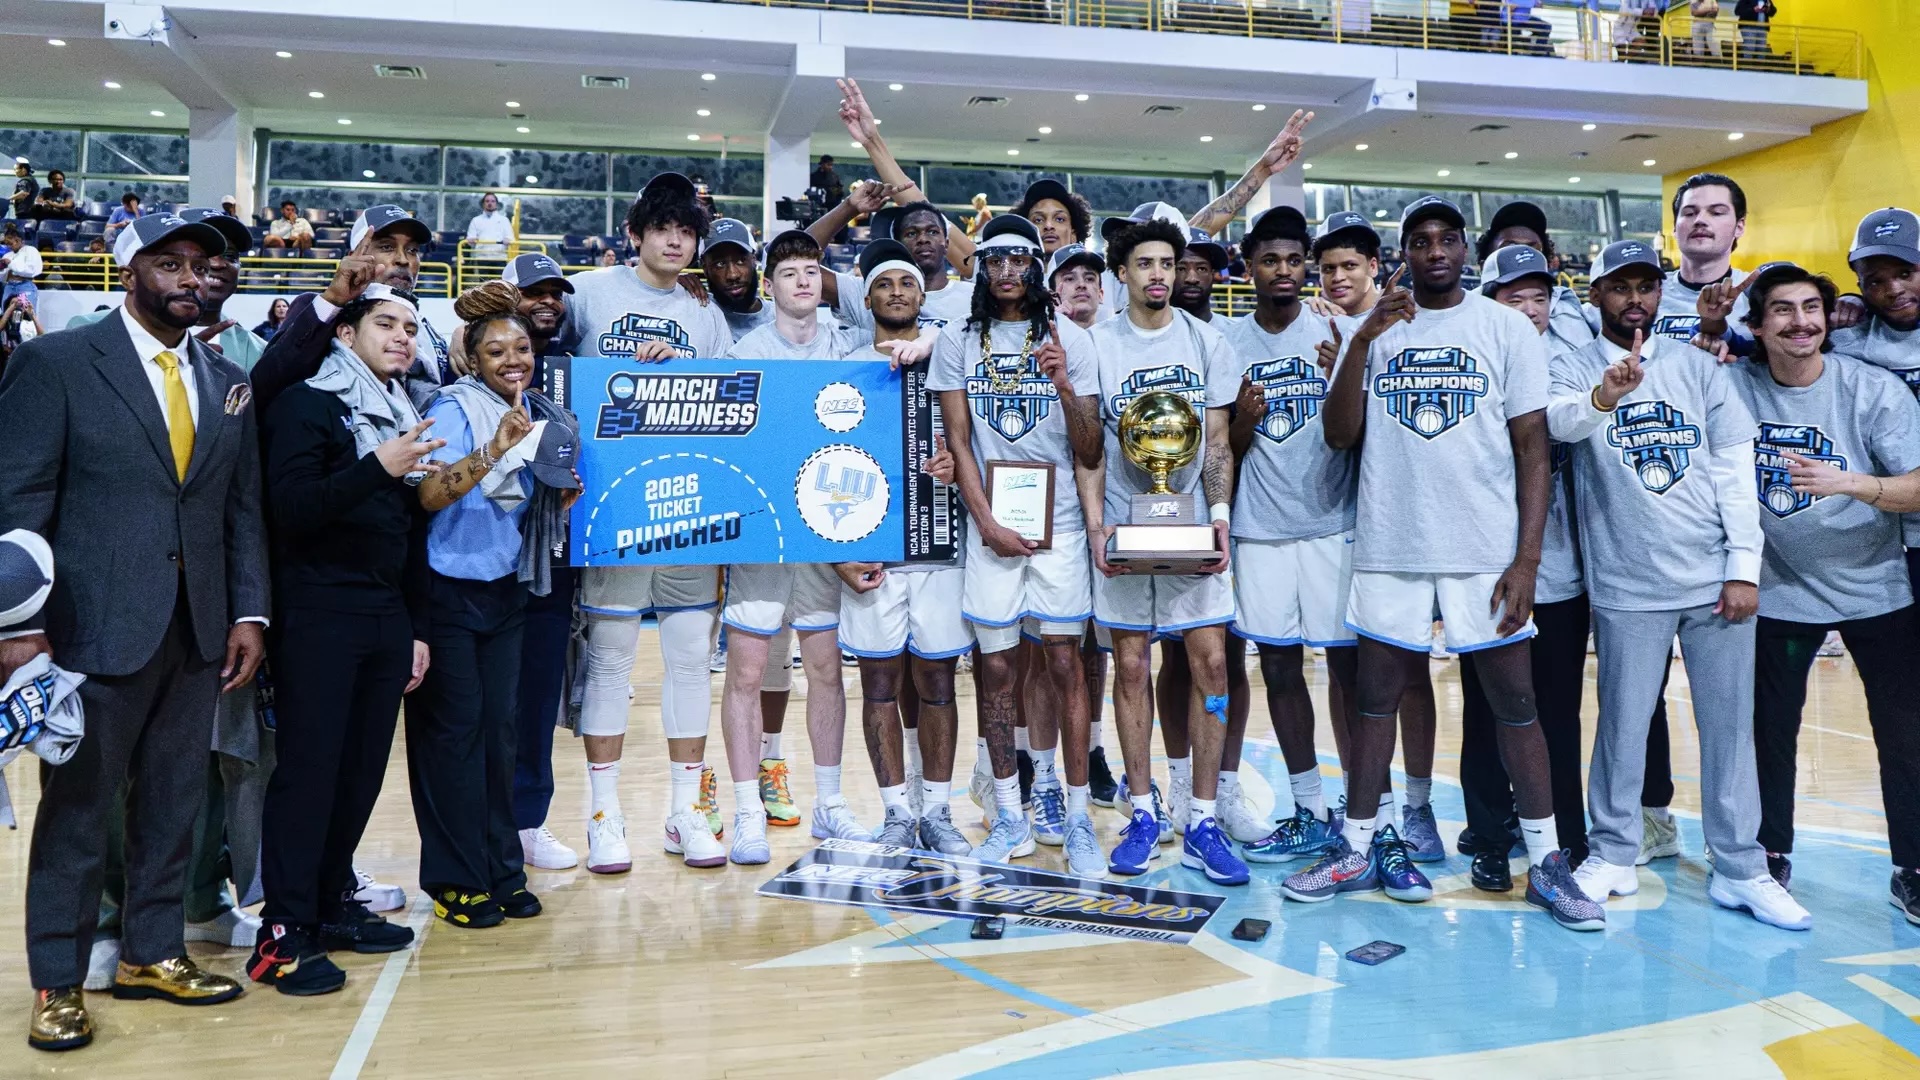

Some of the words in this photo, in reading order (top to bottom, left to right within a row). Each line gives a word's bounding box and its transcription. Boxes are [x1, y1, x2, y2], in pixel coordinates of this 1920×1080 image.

[636, 318, 669, 329] NEC
[643, 333, 676, 344] BASKETBALL
[602, 338, 694, 359] CHANS
[1412, 348, 1452, 362] NEC
[996, 356, 1021, 368] NE
[1260, 358, 1292, 376] NEC
[918, 373, 926, 384] 26
[1144, 366, 1176, 382] NEC
[1270, 374, 1301, 384] BASKETBALL
[634, 378, 718, 400] MARCH
[1153, 382, 1186, 391] BASKETBALL
[1264, 382, 1324, 399] MPIONS
[1379, 376, 1484, 392] CHAMPIONS
[907, 371, 917, 417] QUALIFIER
[918, 387, 926, 408] SEAT
[644, 402, 755, 426] MADNESS
[822, 398, 858, 412] NEC
[1626, 402, 1656, 420] NEC
[1618, 424, 1636, 432] MEN'S
[1769, 427, 1807, 438] NEC
[908, 418, 917, 470] AUTOMATIC
[920, 440, 927, 451] 15
[645, 473, 698, 502] 2026
[814, 462, 878, 501] LIU
[1004, 472, 1038, 488] NEC
[648, 496, 702, 520] TICKET
[908, 471, 918, 530] TOURNAMENT
[1149, 501, 1180, 514] NEC
[616, 512, 741, 559] PUNCHED
[920, 514, 929, 554] SECTION
[910, 532, 918, 555] NCAA
[784, 864, 919, 885] NEC
[873, 859, 1210, 920] Champions
[1014, 917, 1069, 929] MEN'S
[1071, 923, 1176, 941] BASKETBALL
